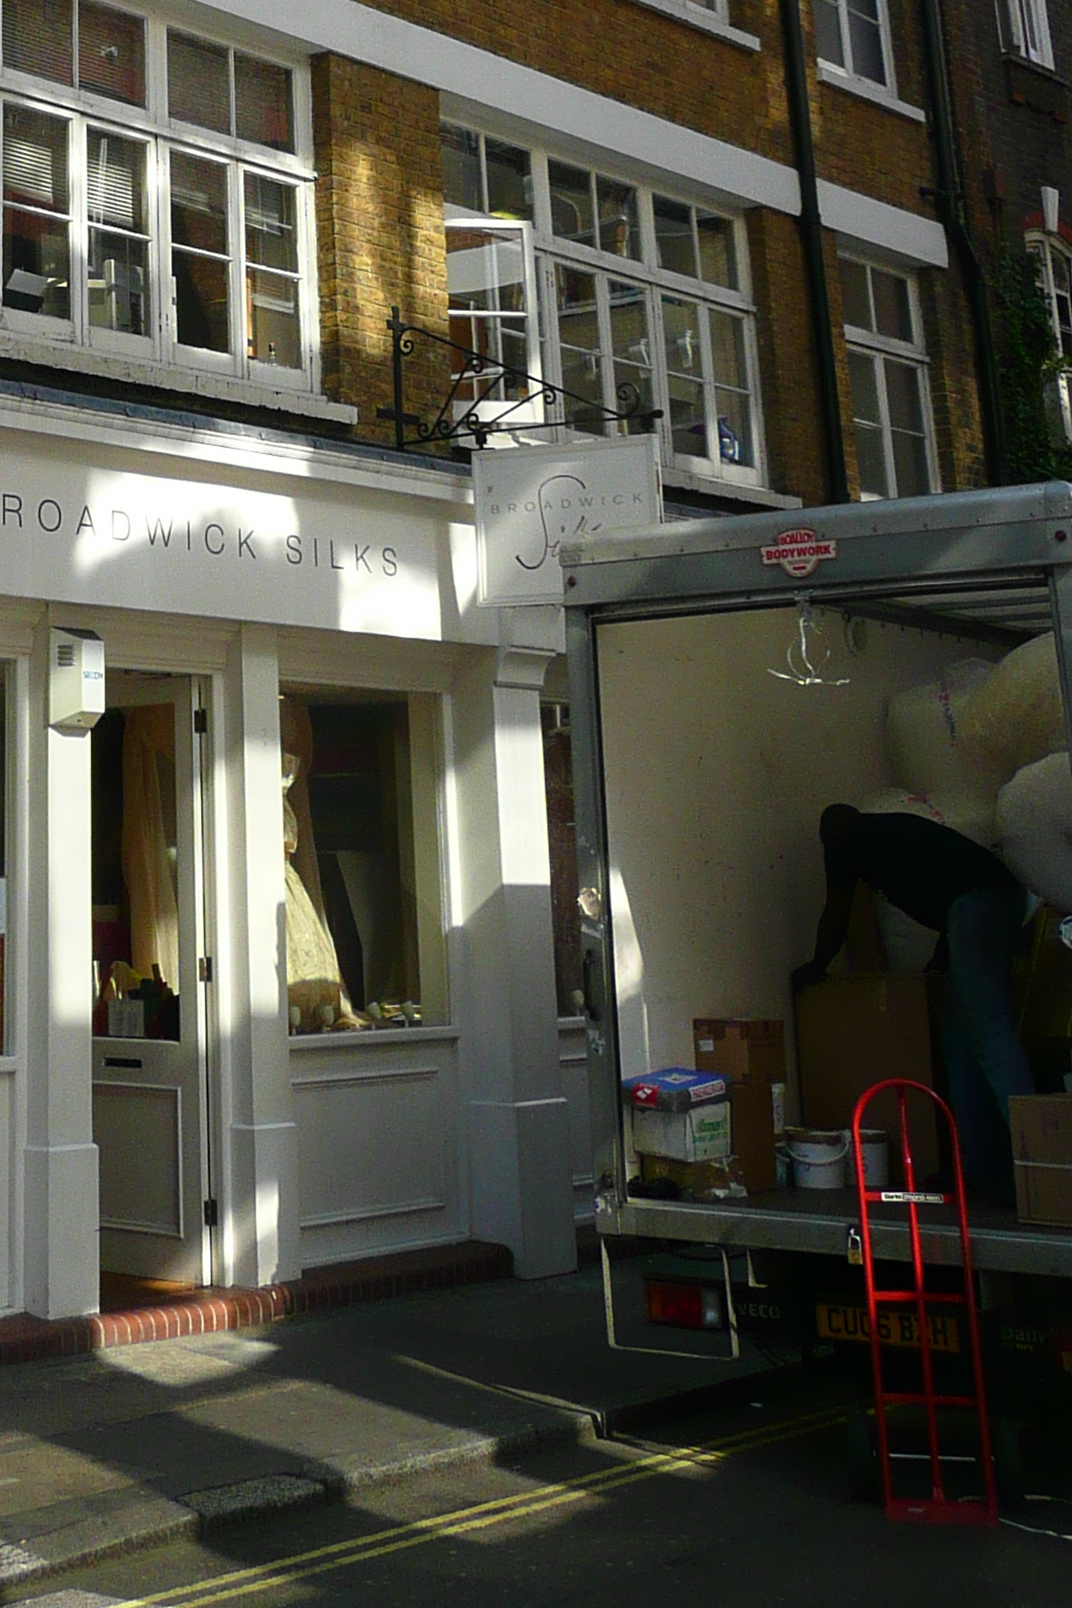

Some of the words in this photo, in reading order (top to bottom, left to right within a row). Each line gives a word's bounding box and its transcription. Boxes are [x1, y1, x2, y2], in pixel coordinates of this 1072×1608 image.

[490, 492, 644, 515] BROADWICK
[285, 534, 398, 577] SILKS
[765, 544, 831, 560] BODYWORK
